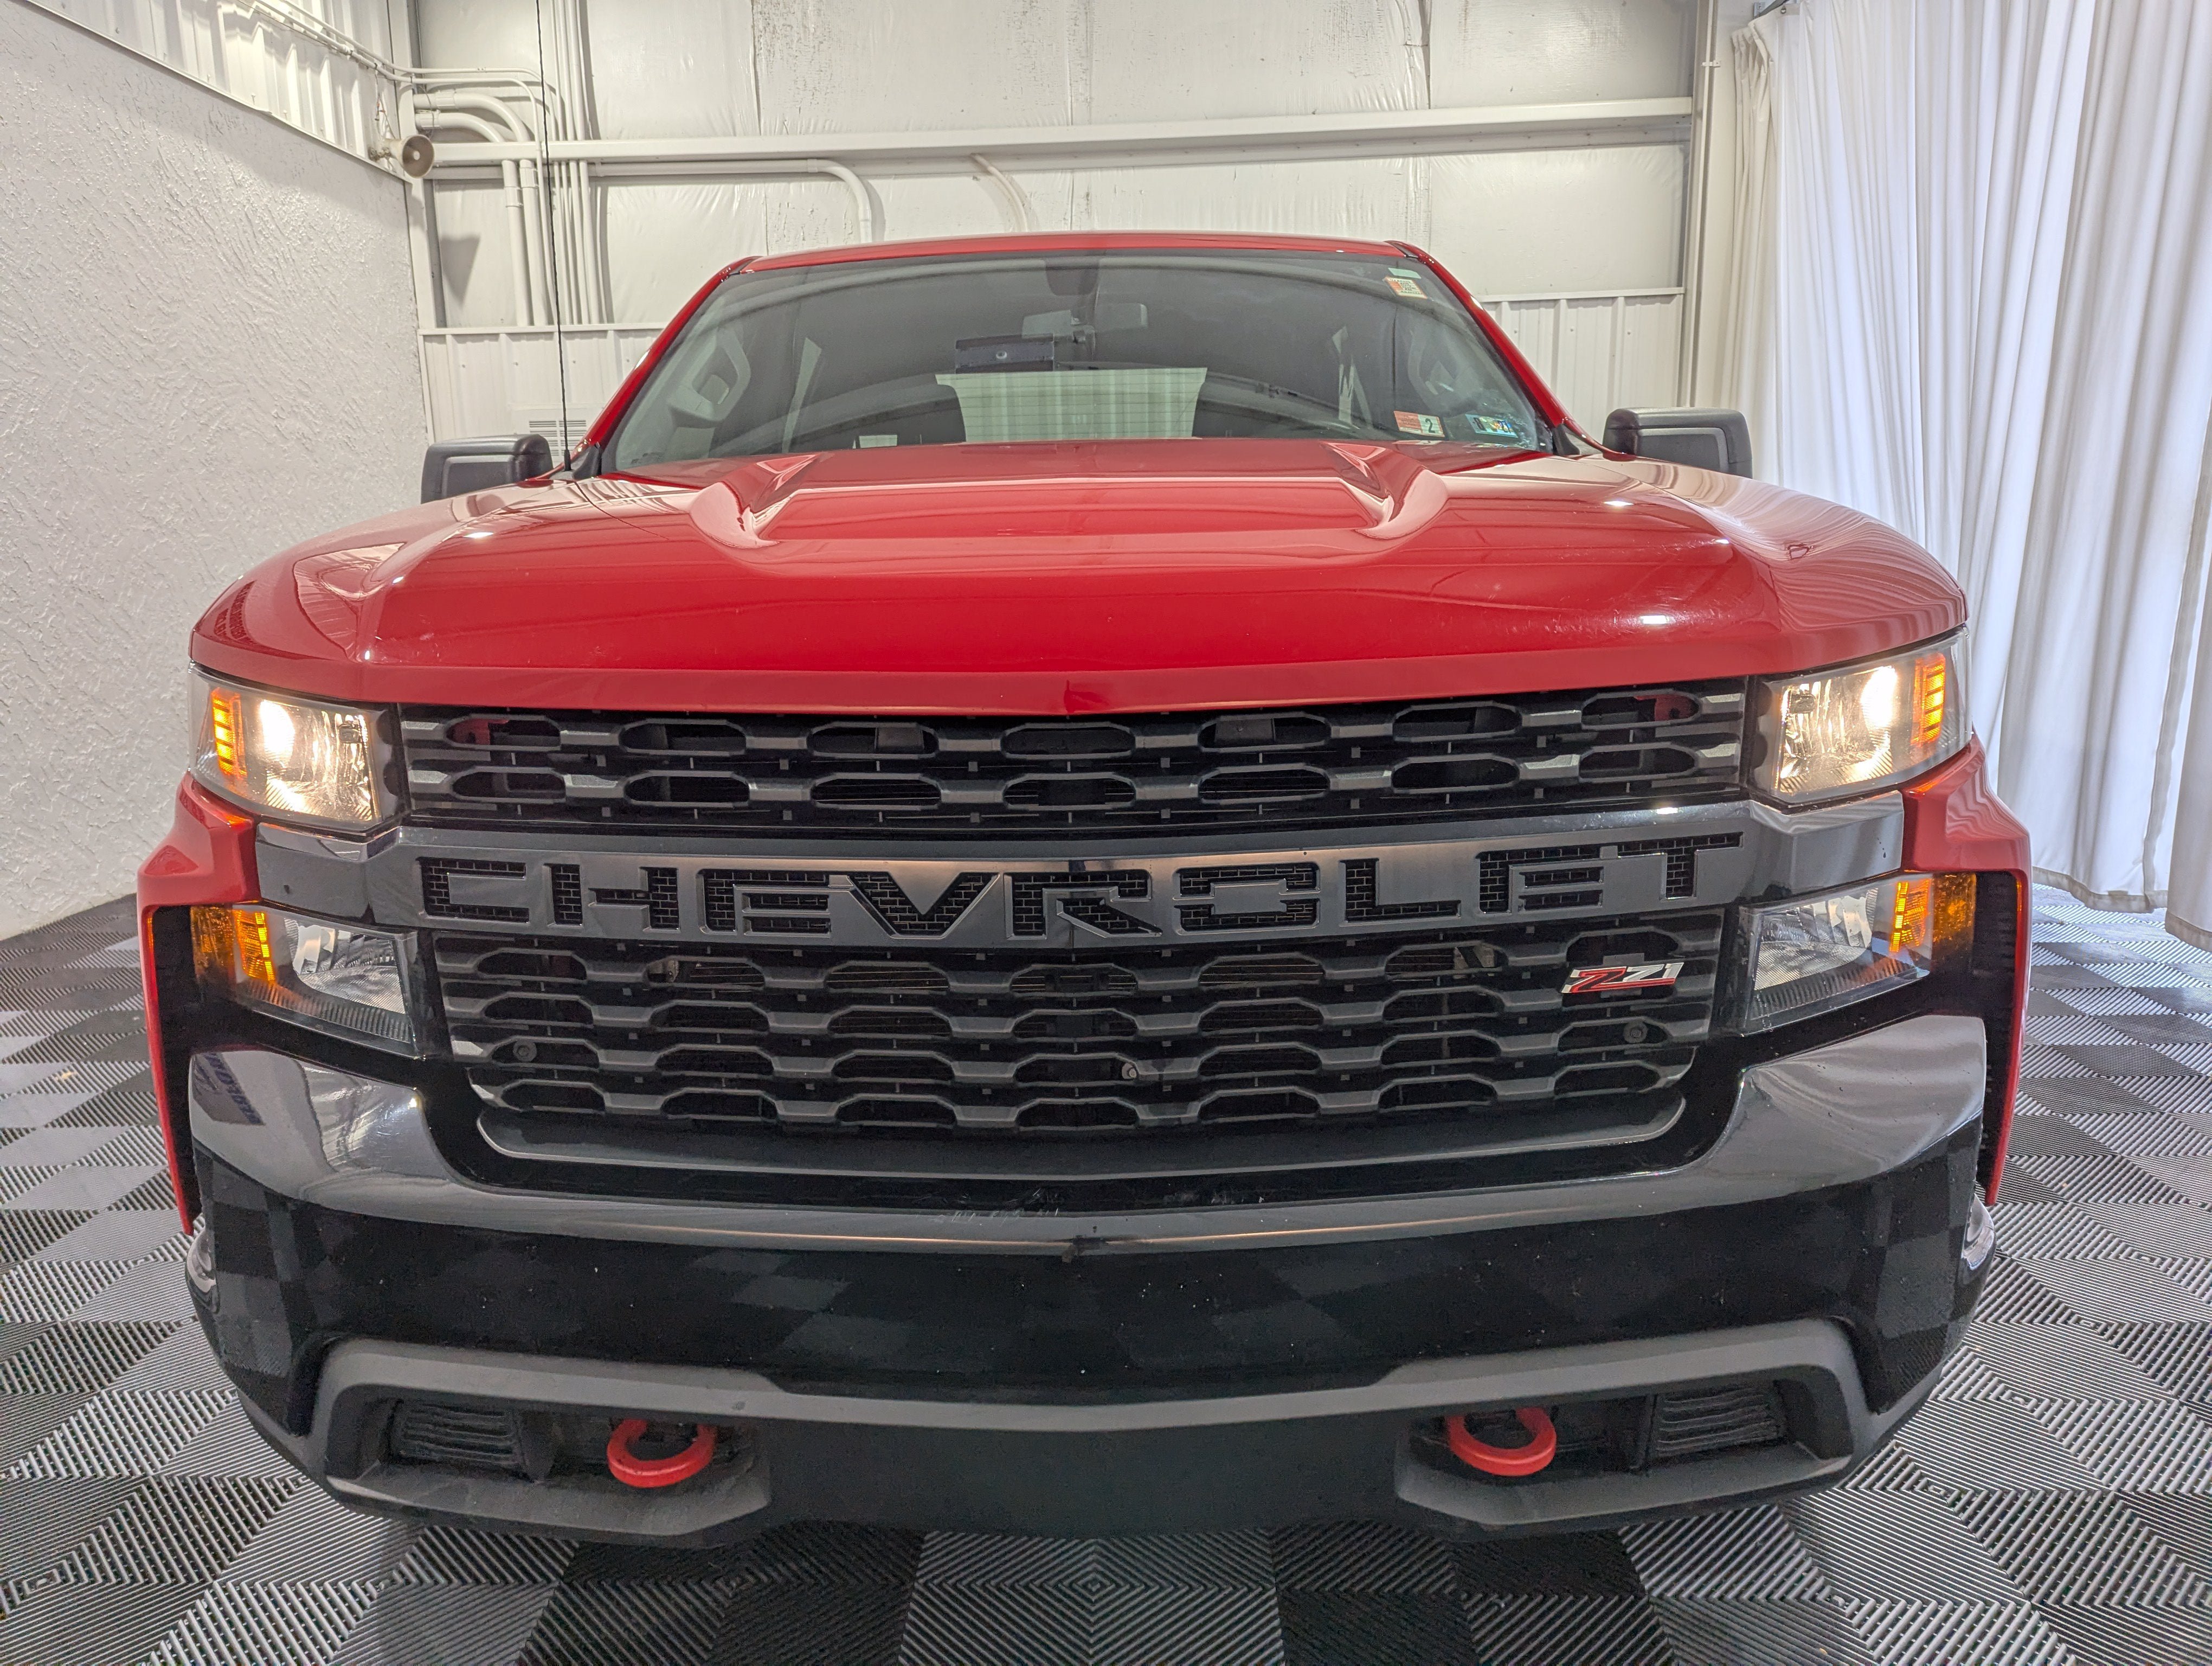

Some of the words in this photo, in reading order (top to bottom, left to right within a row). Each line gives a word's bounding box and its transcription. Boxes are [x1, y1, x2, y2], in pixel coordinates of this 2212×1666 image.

[1425, 418, 1436, 433] 2
[419, 831, 1744, 939] CHEVROLET
[1561, 962, 1684, 994] Z71
